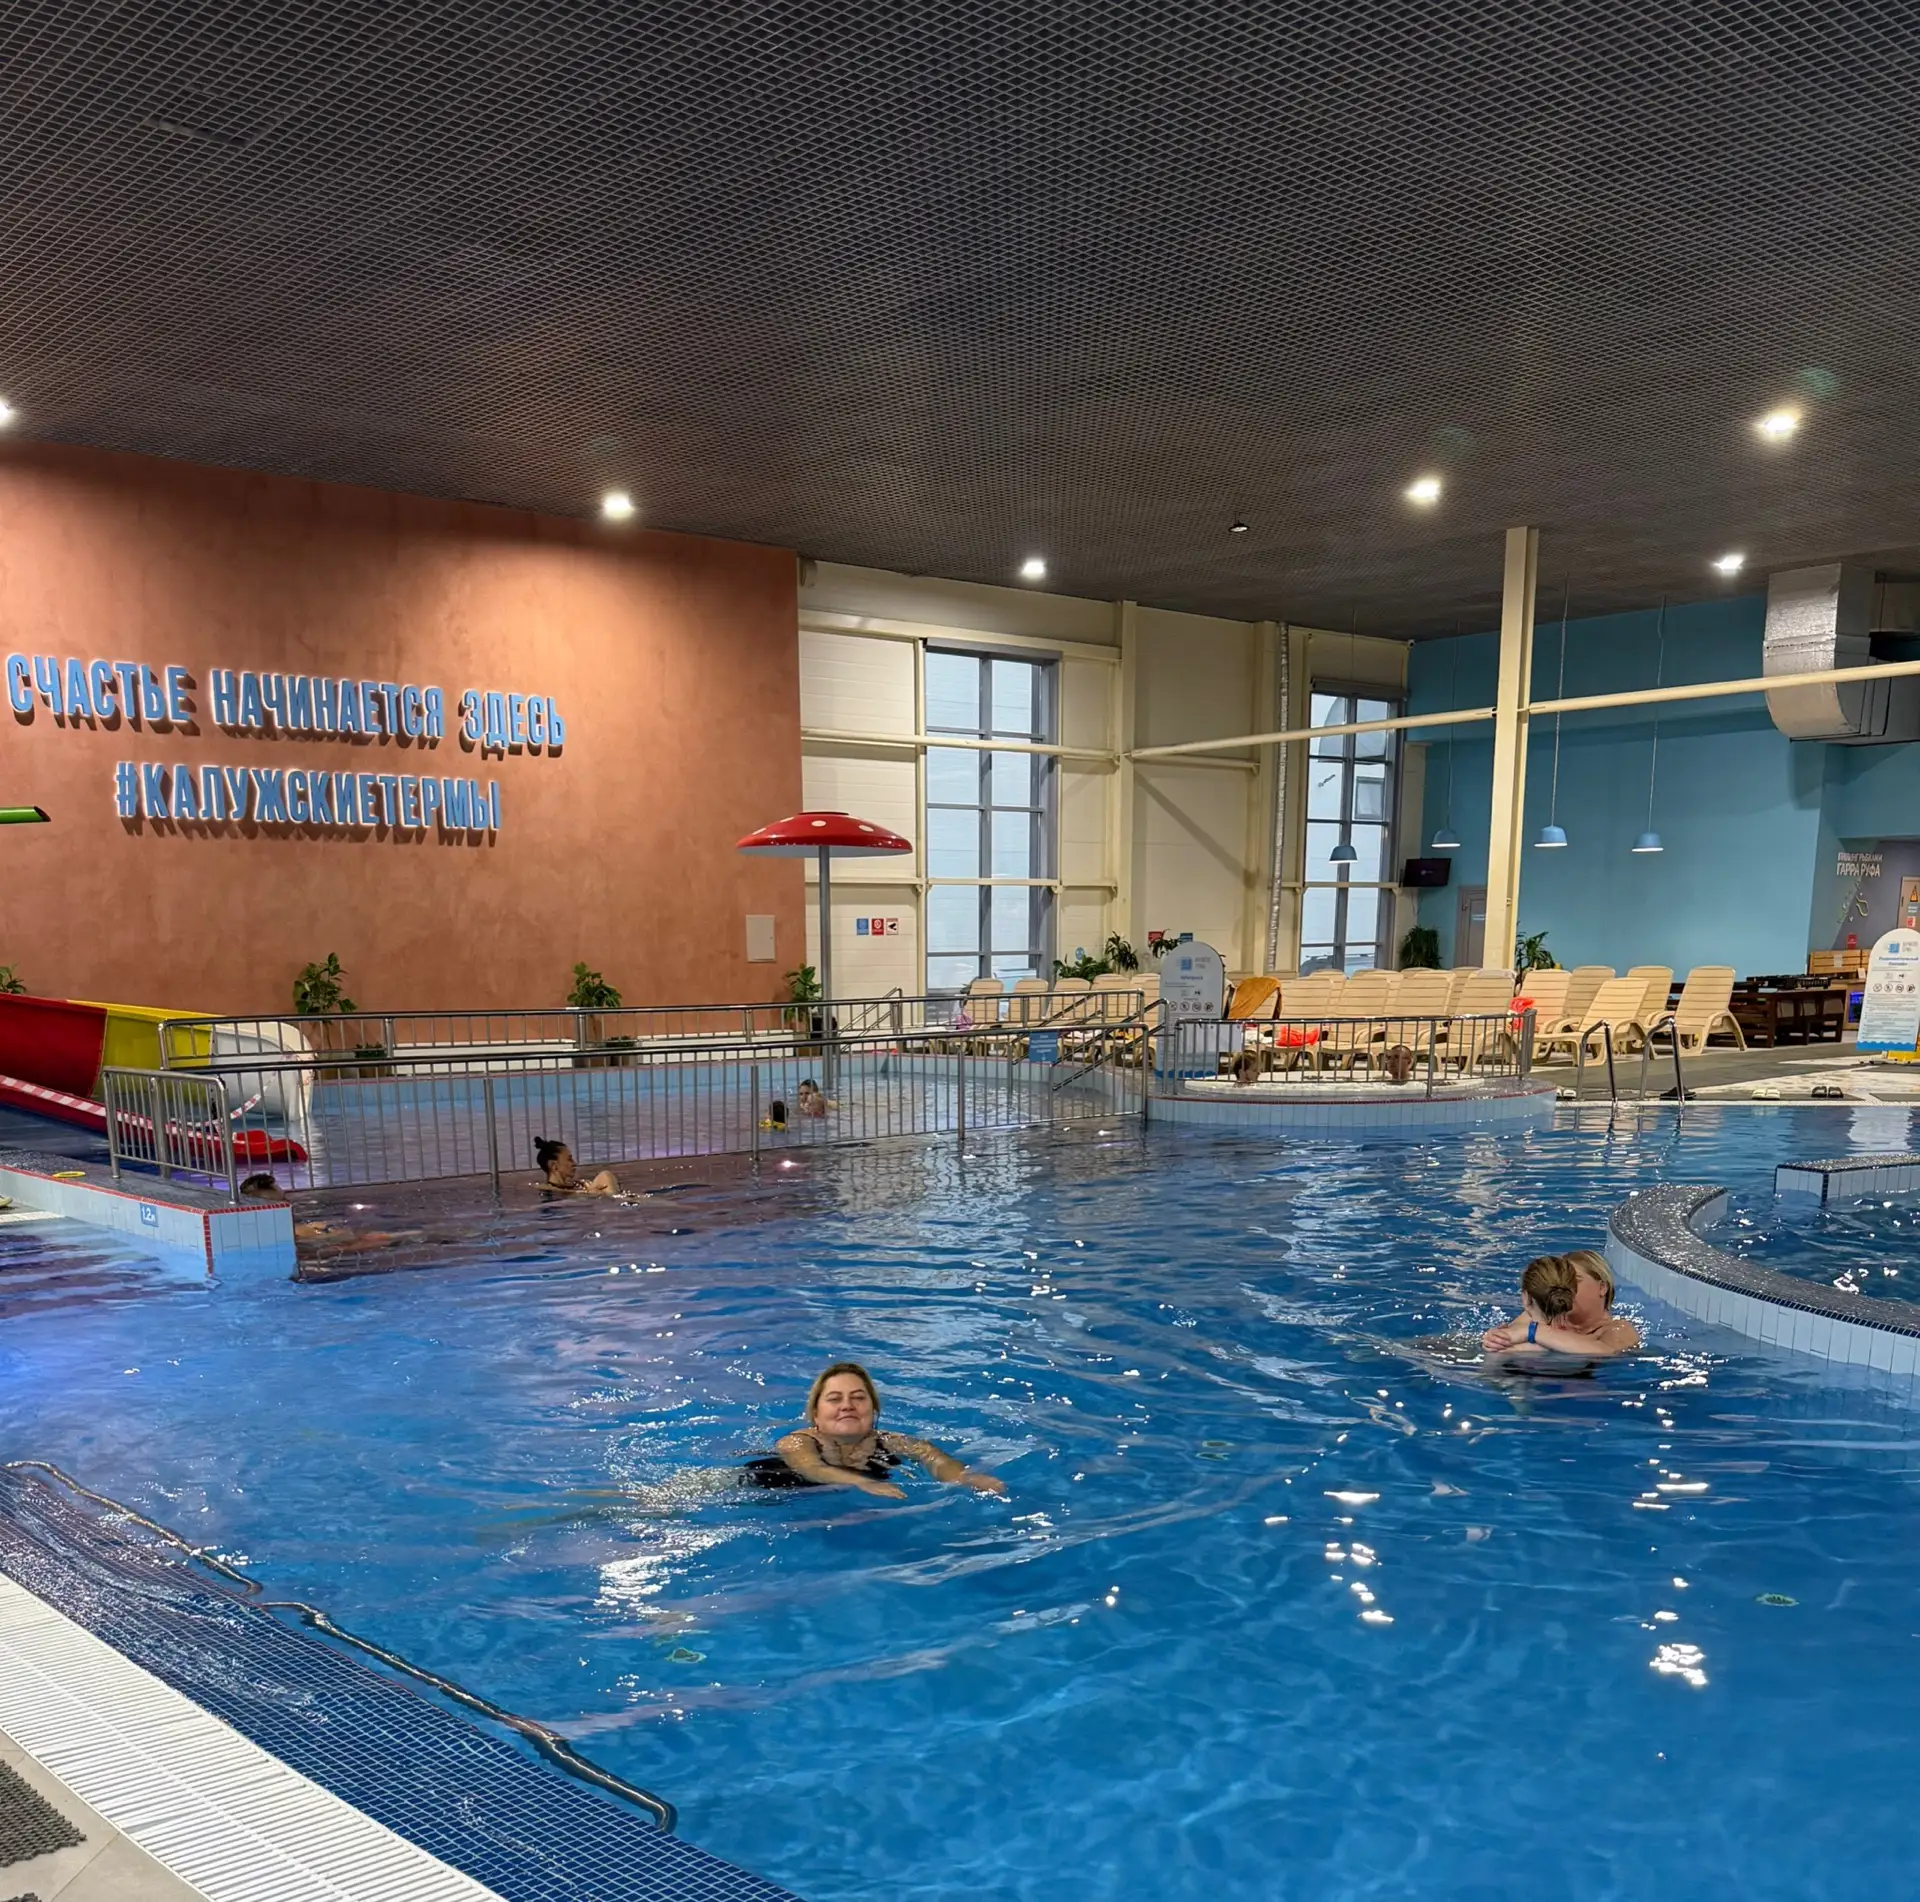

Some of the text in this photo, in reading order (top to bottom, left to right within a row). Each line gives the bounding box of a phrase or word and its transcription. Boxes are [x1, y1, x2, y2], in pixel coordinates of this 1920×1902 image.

[7, 654, 566, 750] СЧАСТЬЕ НАЧИНАЕТСЯ ЗДЕСЬ
[116, 762, 501, 831] #КАЛУЖСКИЕТЕРМЫ
[1836, 862, 1881, 878] ГАРРА РУФА
